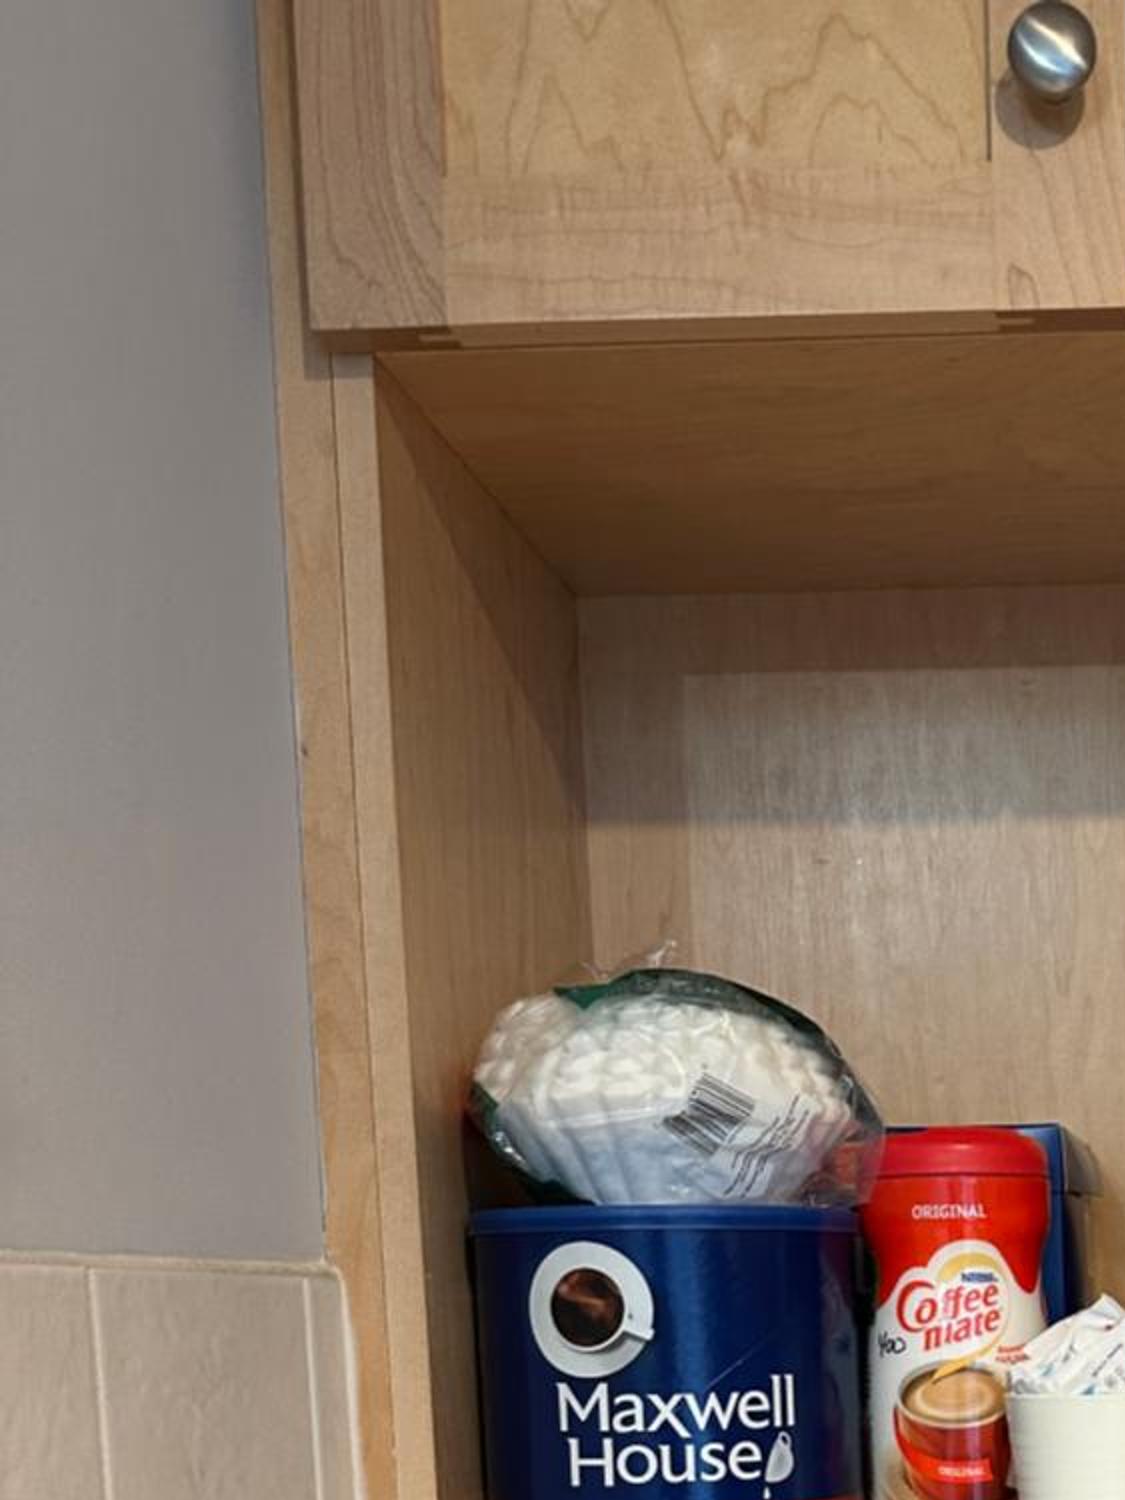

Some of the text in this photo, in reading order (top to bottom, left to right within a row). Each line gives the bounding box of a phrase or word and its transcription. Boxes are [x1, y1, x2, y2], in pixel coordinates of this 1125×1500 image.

[911, 1203, 987, 1219] ORIGINAL
[896, 1279, 1000, 1334] Coffee
[924, 1309, 1001, 1351] mate
[556, 1373, 796, 1438] Maxwell
[567, 1435, 763, 1487] House
